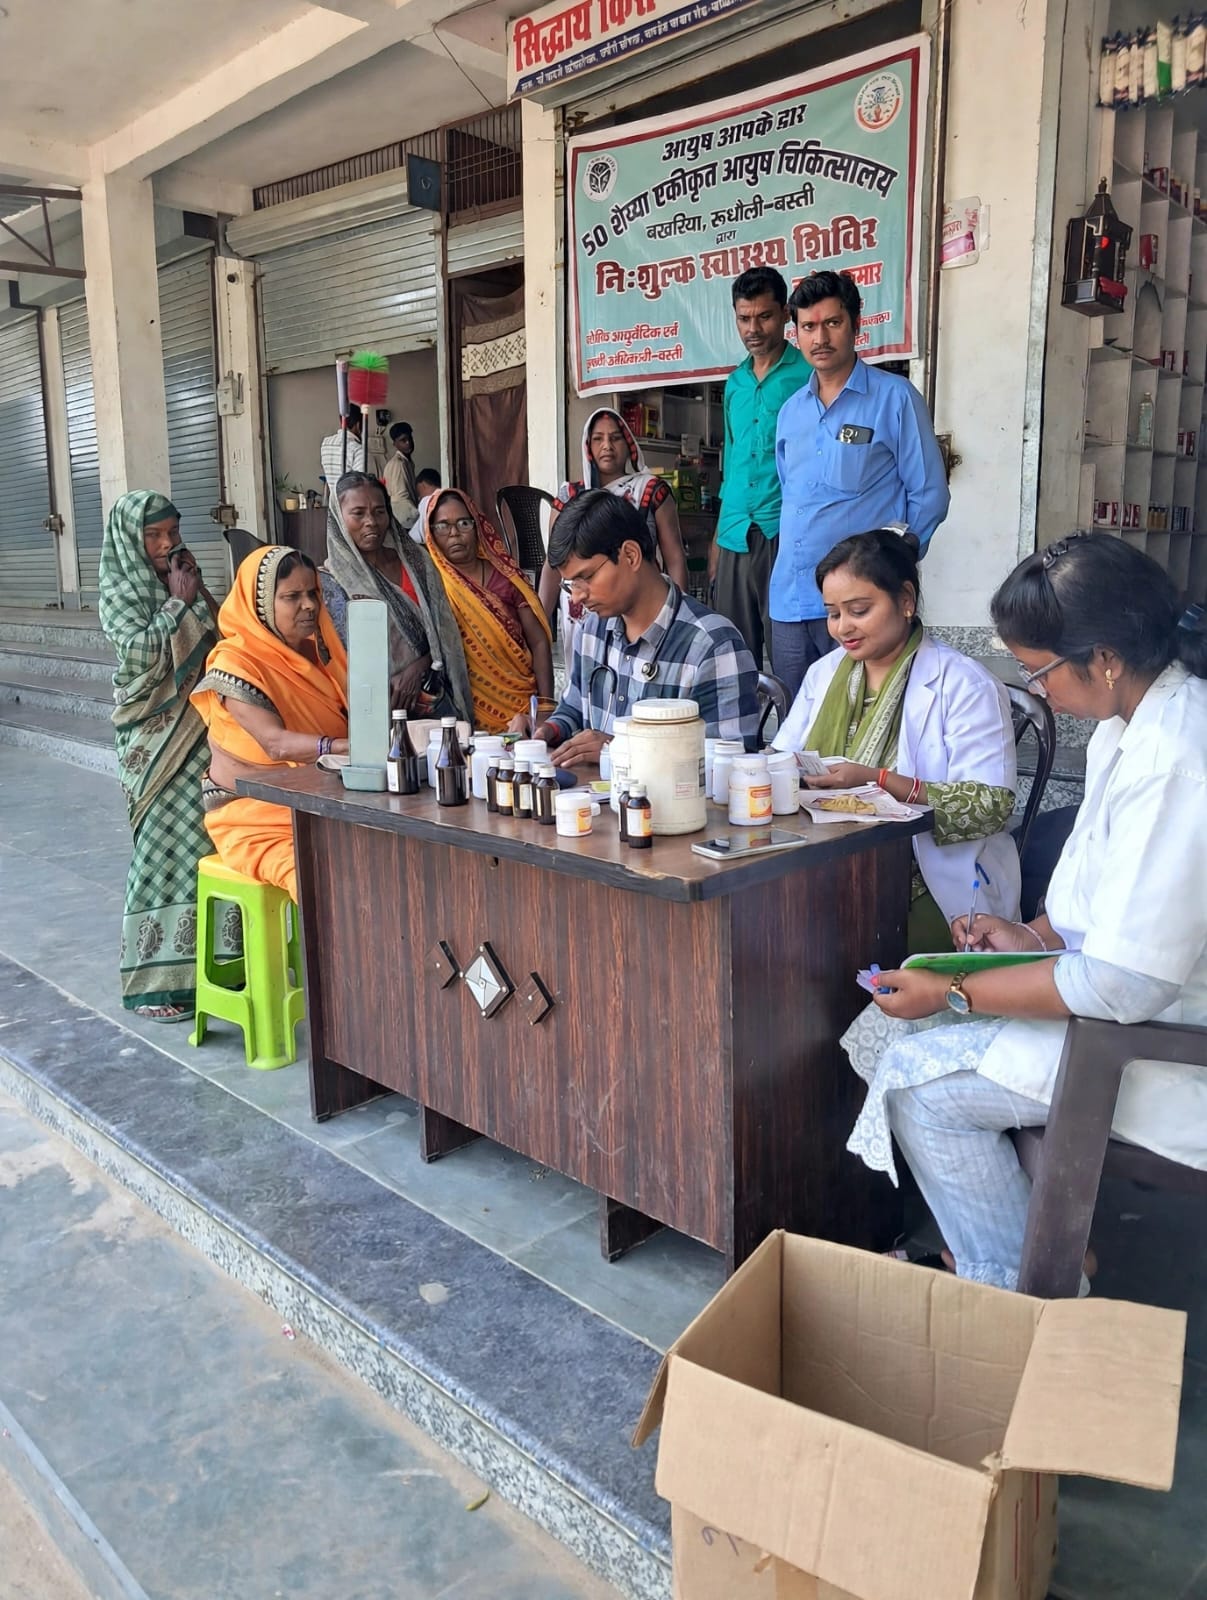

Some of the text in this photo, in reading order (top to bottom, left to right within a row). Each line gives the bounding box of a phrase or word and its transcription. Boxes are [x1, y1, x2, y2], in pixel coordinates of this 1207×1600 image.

[662, 104, 807, 161] आयुष आपके द्वार
[581, 224, 609, 256] 50
[611, 204, 650, 236] शैय्या
[652, 162, 718, 207] एकीकृत
[722, 150, 775, 186] आयुष
[777, 140, 898, 198] चिकित्सालय
[646, 212, 707, 240] बखरिया,
[793, 215, 878, 263] शिविर
